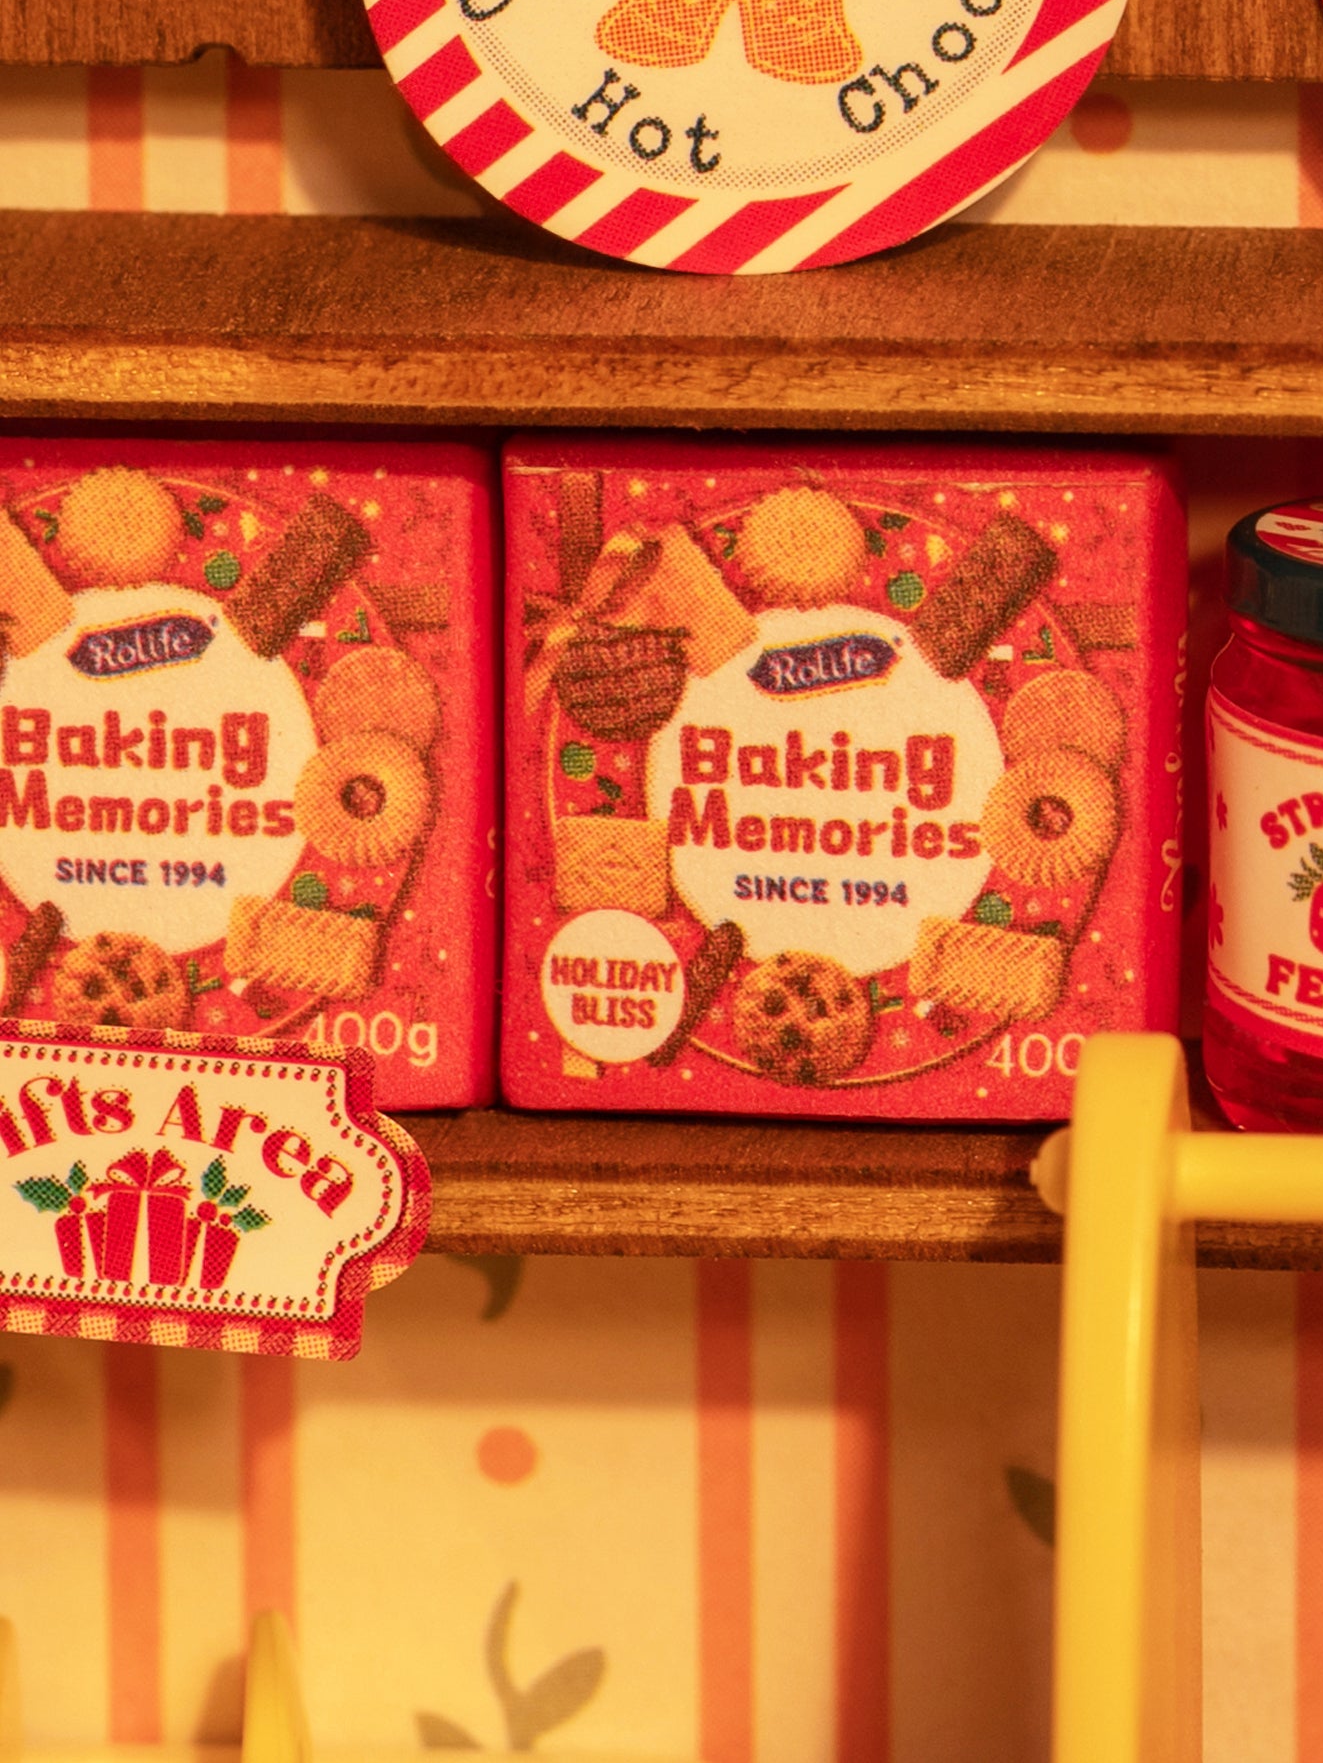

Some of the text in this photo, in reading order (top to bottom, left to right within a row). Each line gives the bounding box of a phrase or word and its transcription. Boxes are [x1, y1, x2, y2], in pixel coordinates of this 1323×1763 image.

[570, 68, 722, 174] Hot
[1, 704, 271, 790] Baking
[679, 724, 956, 810] Baking
[0, 767, 297, 838] Memories
[668, 787, 982, 860] Memories
[55, 857, 227, 888] SINCE 1994
[733, 873, 909, 906] SINCE 1994
[550, 953, 679, 995] HOLIDAY
[302, 1010, 438, 1068] 400g
[570, 992, 657, 1030] BLISS
[156, 1081, 355, 1221] Area
